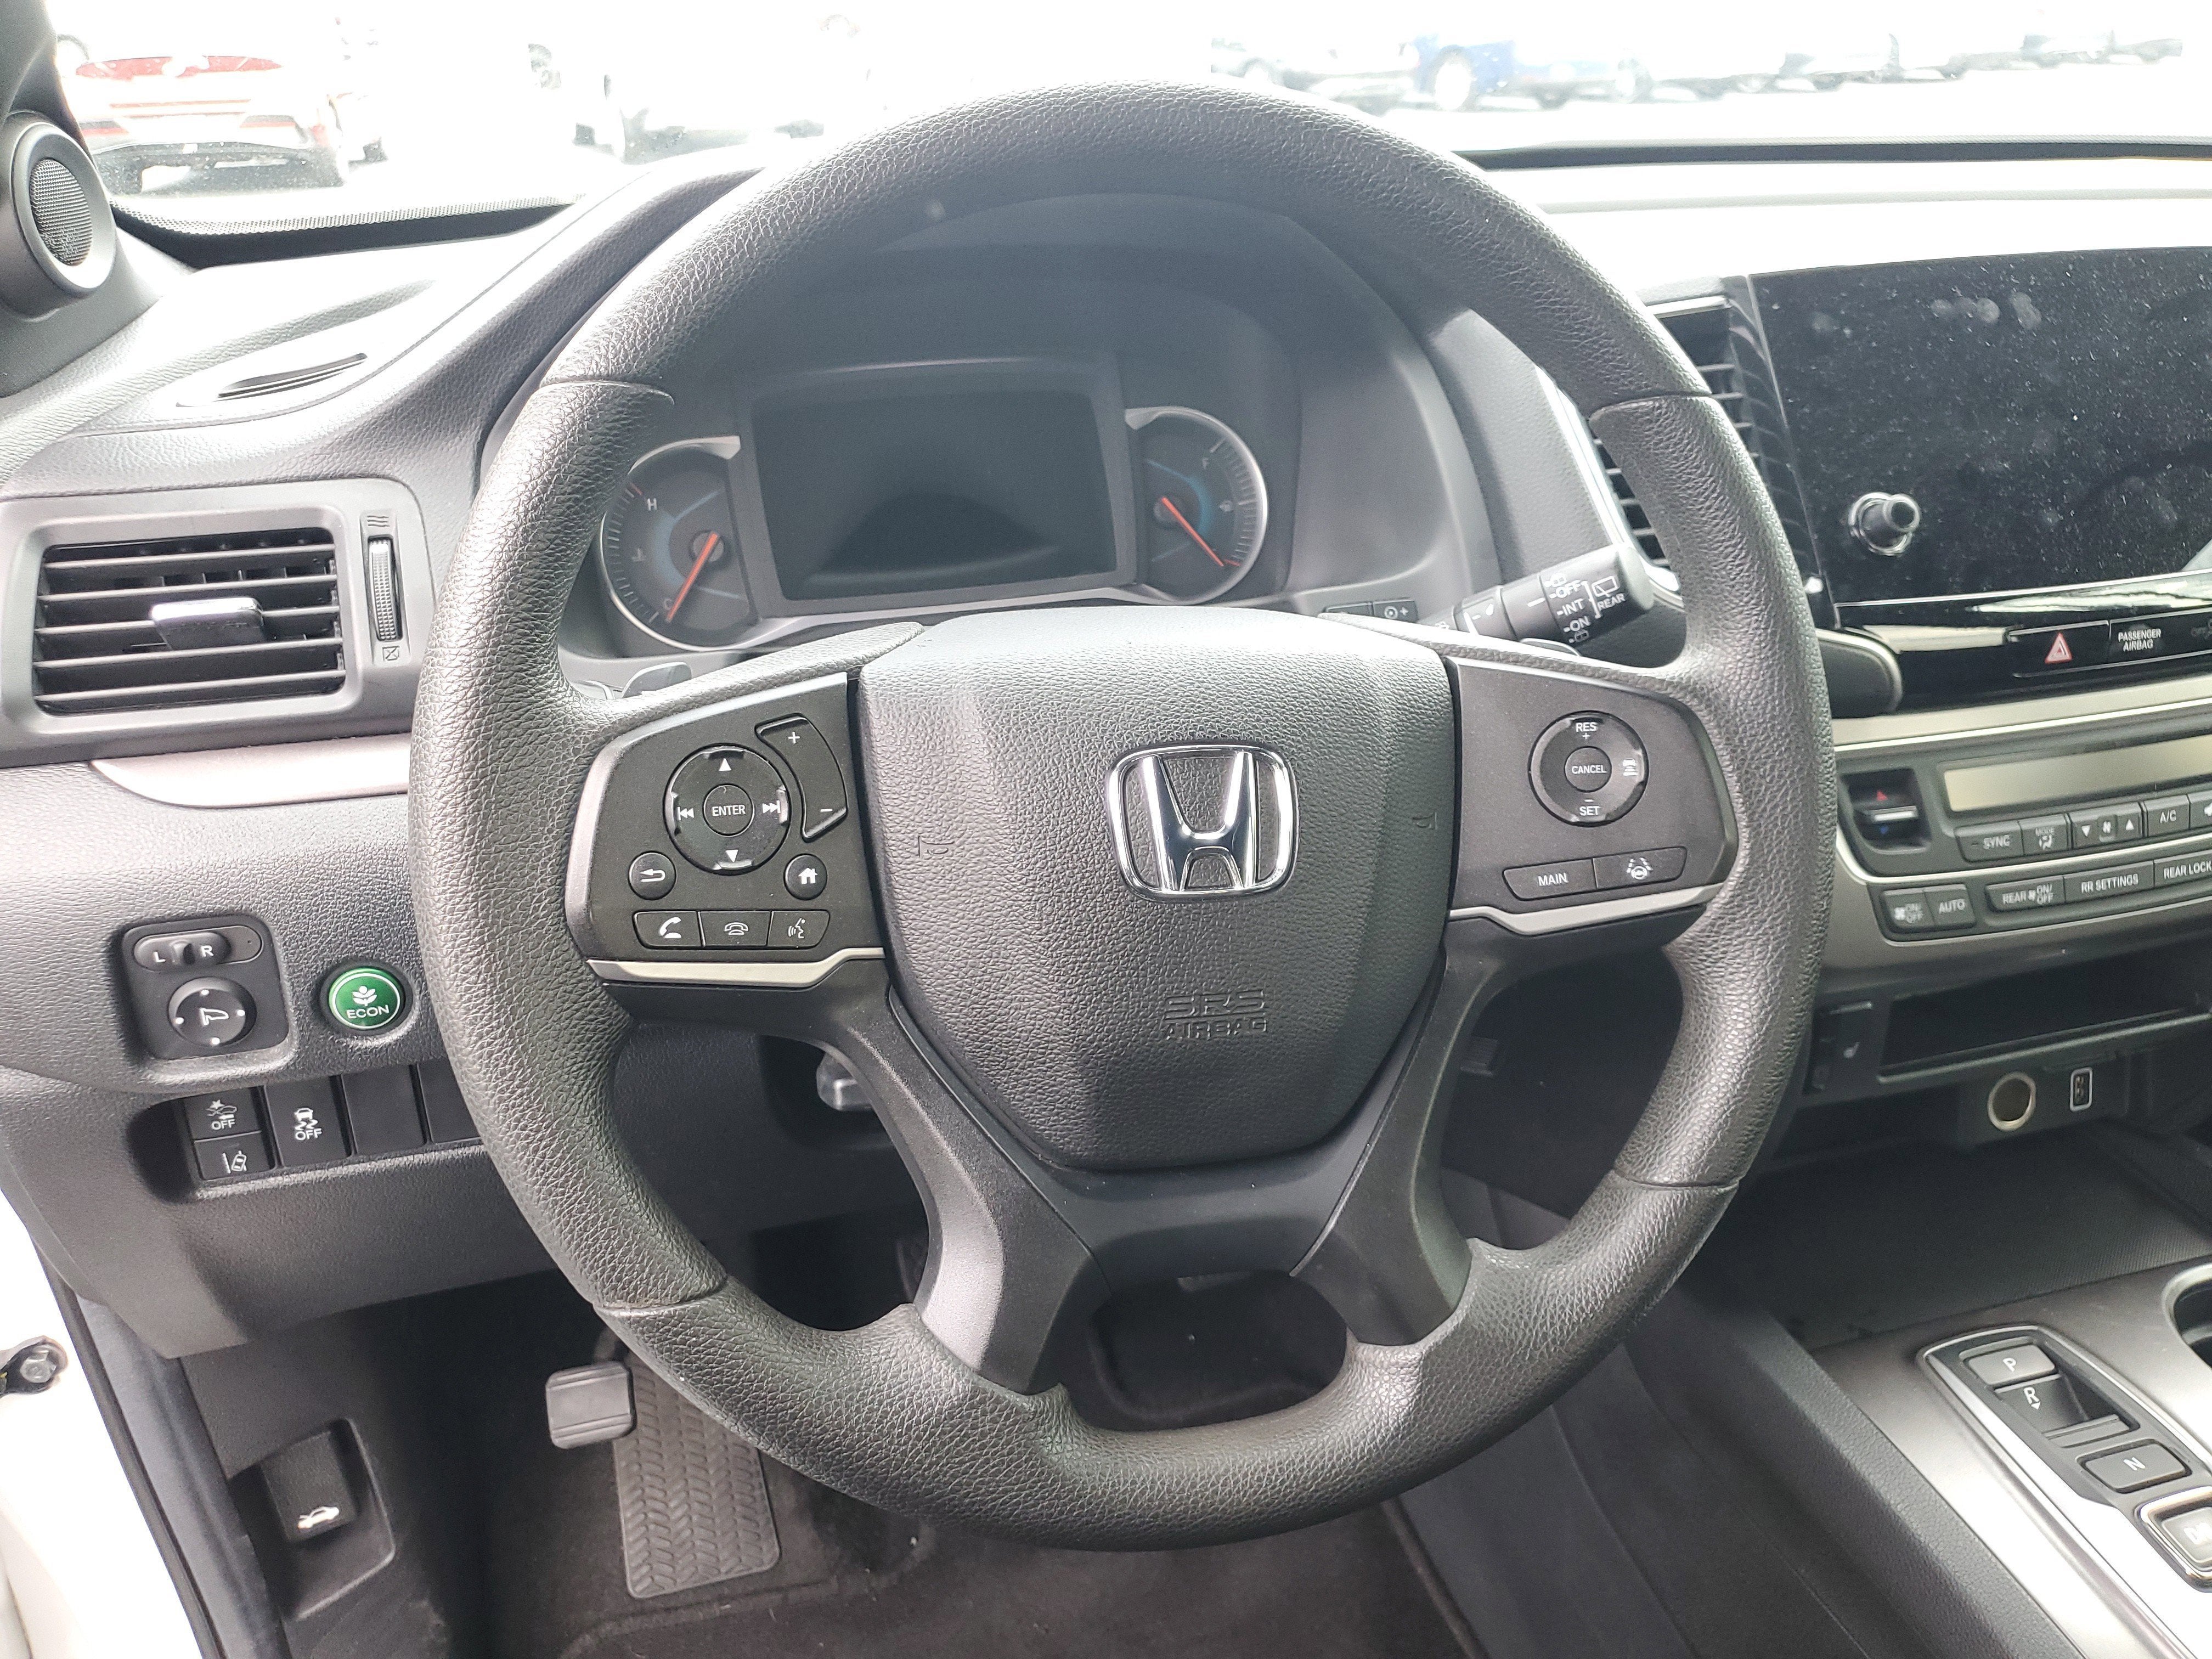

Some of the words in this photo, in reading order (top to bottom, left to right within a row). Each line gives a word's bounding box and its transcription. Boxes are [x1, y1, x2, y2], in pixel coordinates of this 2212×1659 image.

[647, 498, 658, 511] H
[1556, 579, 1582, 598] OFF
[1562, 598, 1585, 616] INT
[1598, 592, 1626, 611] REAR
[1570, 616, 1591, 631] ON
[2118, 628, 2162, 642] PASSENGER
[2123, 639, 2153, 652] AIRBAG
[1576, 721, 1597, 732] RES
[1571, 764, 1607, 775] CANCEL
[712, 804, 746, 817] ENTER
[1579, 805, 1600, 816] SET
[2159, 809, 2177, 823] A/C
[1983, 834, 2011, 850] SYNC
[2163, 865, 2187, 880] REAR
[2188, 860, 2212, 876] LOCK
[1538, 872, 1569, 887] MAIN
[2081, 881, 2094, 894] RR
[2095, 873, 2140, 892] SETTINGS
[2002, 891, 2027, 905] REAR
[2036, 892, 2053, 905] OFF
[1939, 898, 1966, 915] AUTO
[154, 951, 166, 963] L
[201, 945, 215, 958] R
[1164, 988, 1266, 1019] SRS
[346, 1004, 390, 1019] ECON
[1163, 1017, 1267, 1041] AIRBAG
[211, 1118, 235, 1131] OFF
[295, 1127, 323, 1141] OFF
[2002, 1357, 2017, 1372] P
[2023, 1386, 2040, 1404] R
[2123, 1457, 2146, 1471] N
